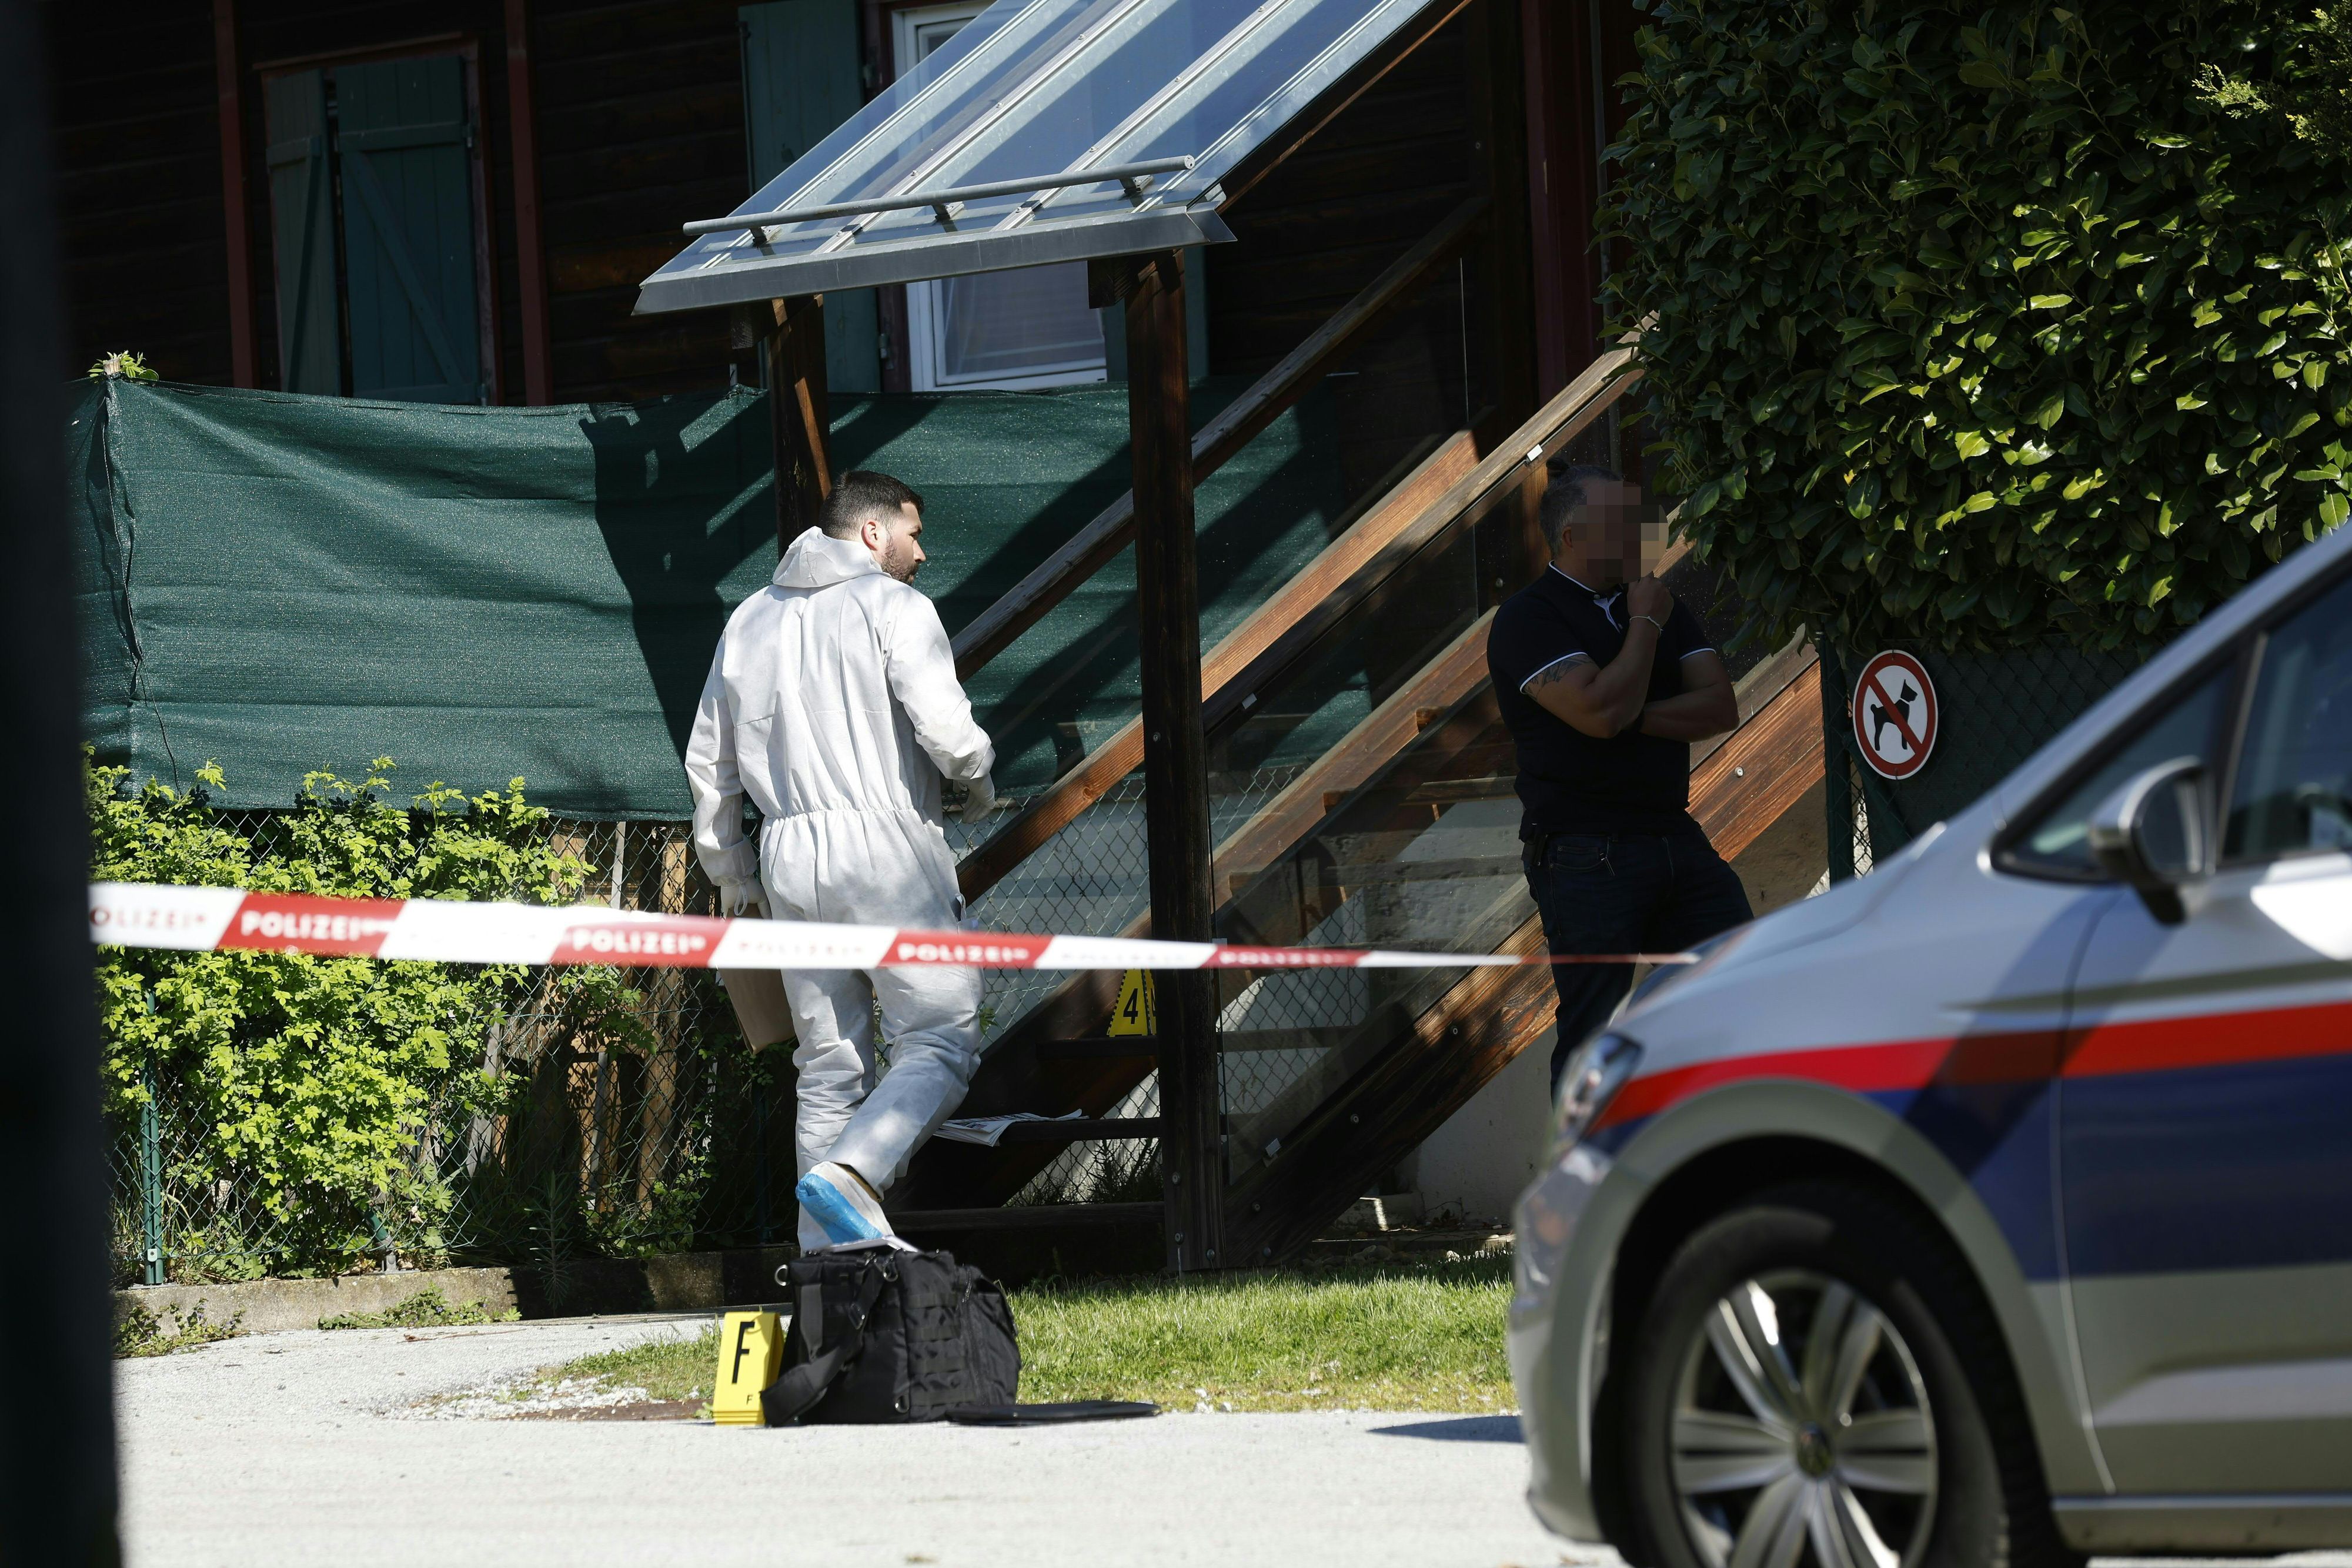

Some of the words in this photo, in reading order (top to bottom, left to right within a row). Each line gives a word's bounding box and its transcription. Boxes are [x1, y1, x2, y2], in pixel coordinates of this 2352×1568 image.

[90, 905, 190, 930] OLIZEI
[240, 910, 360, 941] POLIZEI
[573, 928, 689, 955] POLIZEI
[898, 943, 1013, 963] POLIZEI
[1123, 988, 1138, 1024] 4
[732, 1322, 755, 1383] F
[746, 1395, 753, 1405] F
